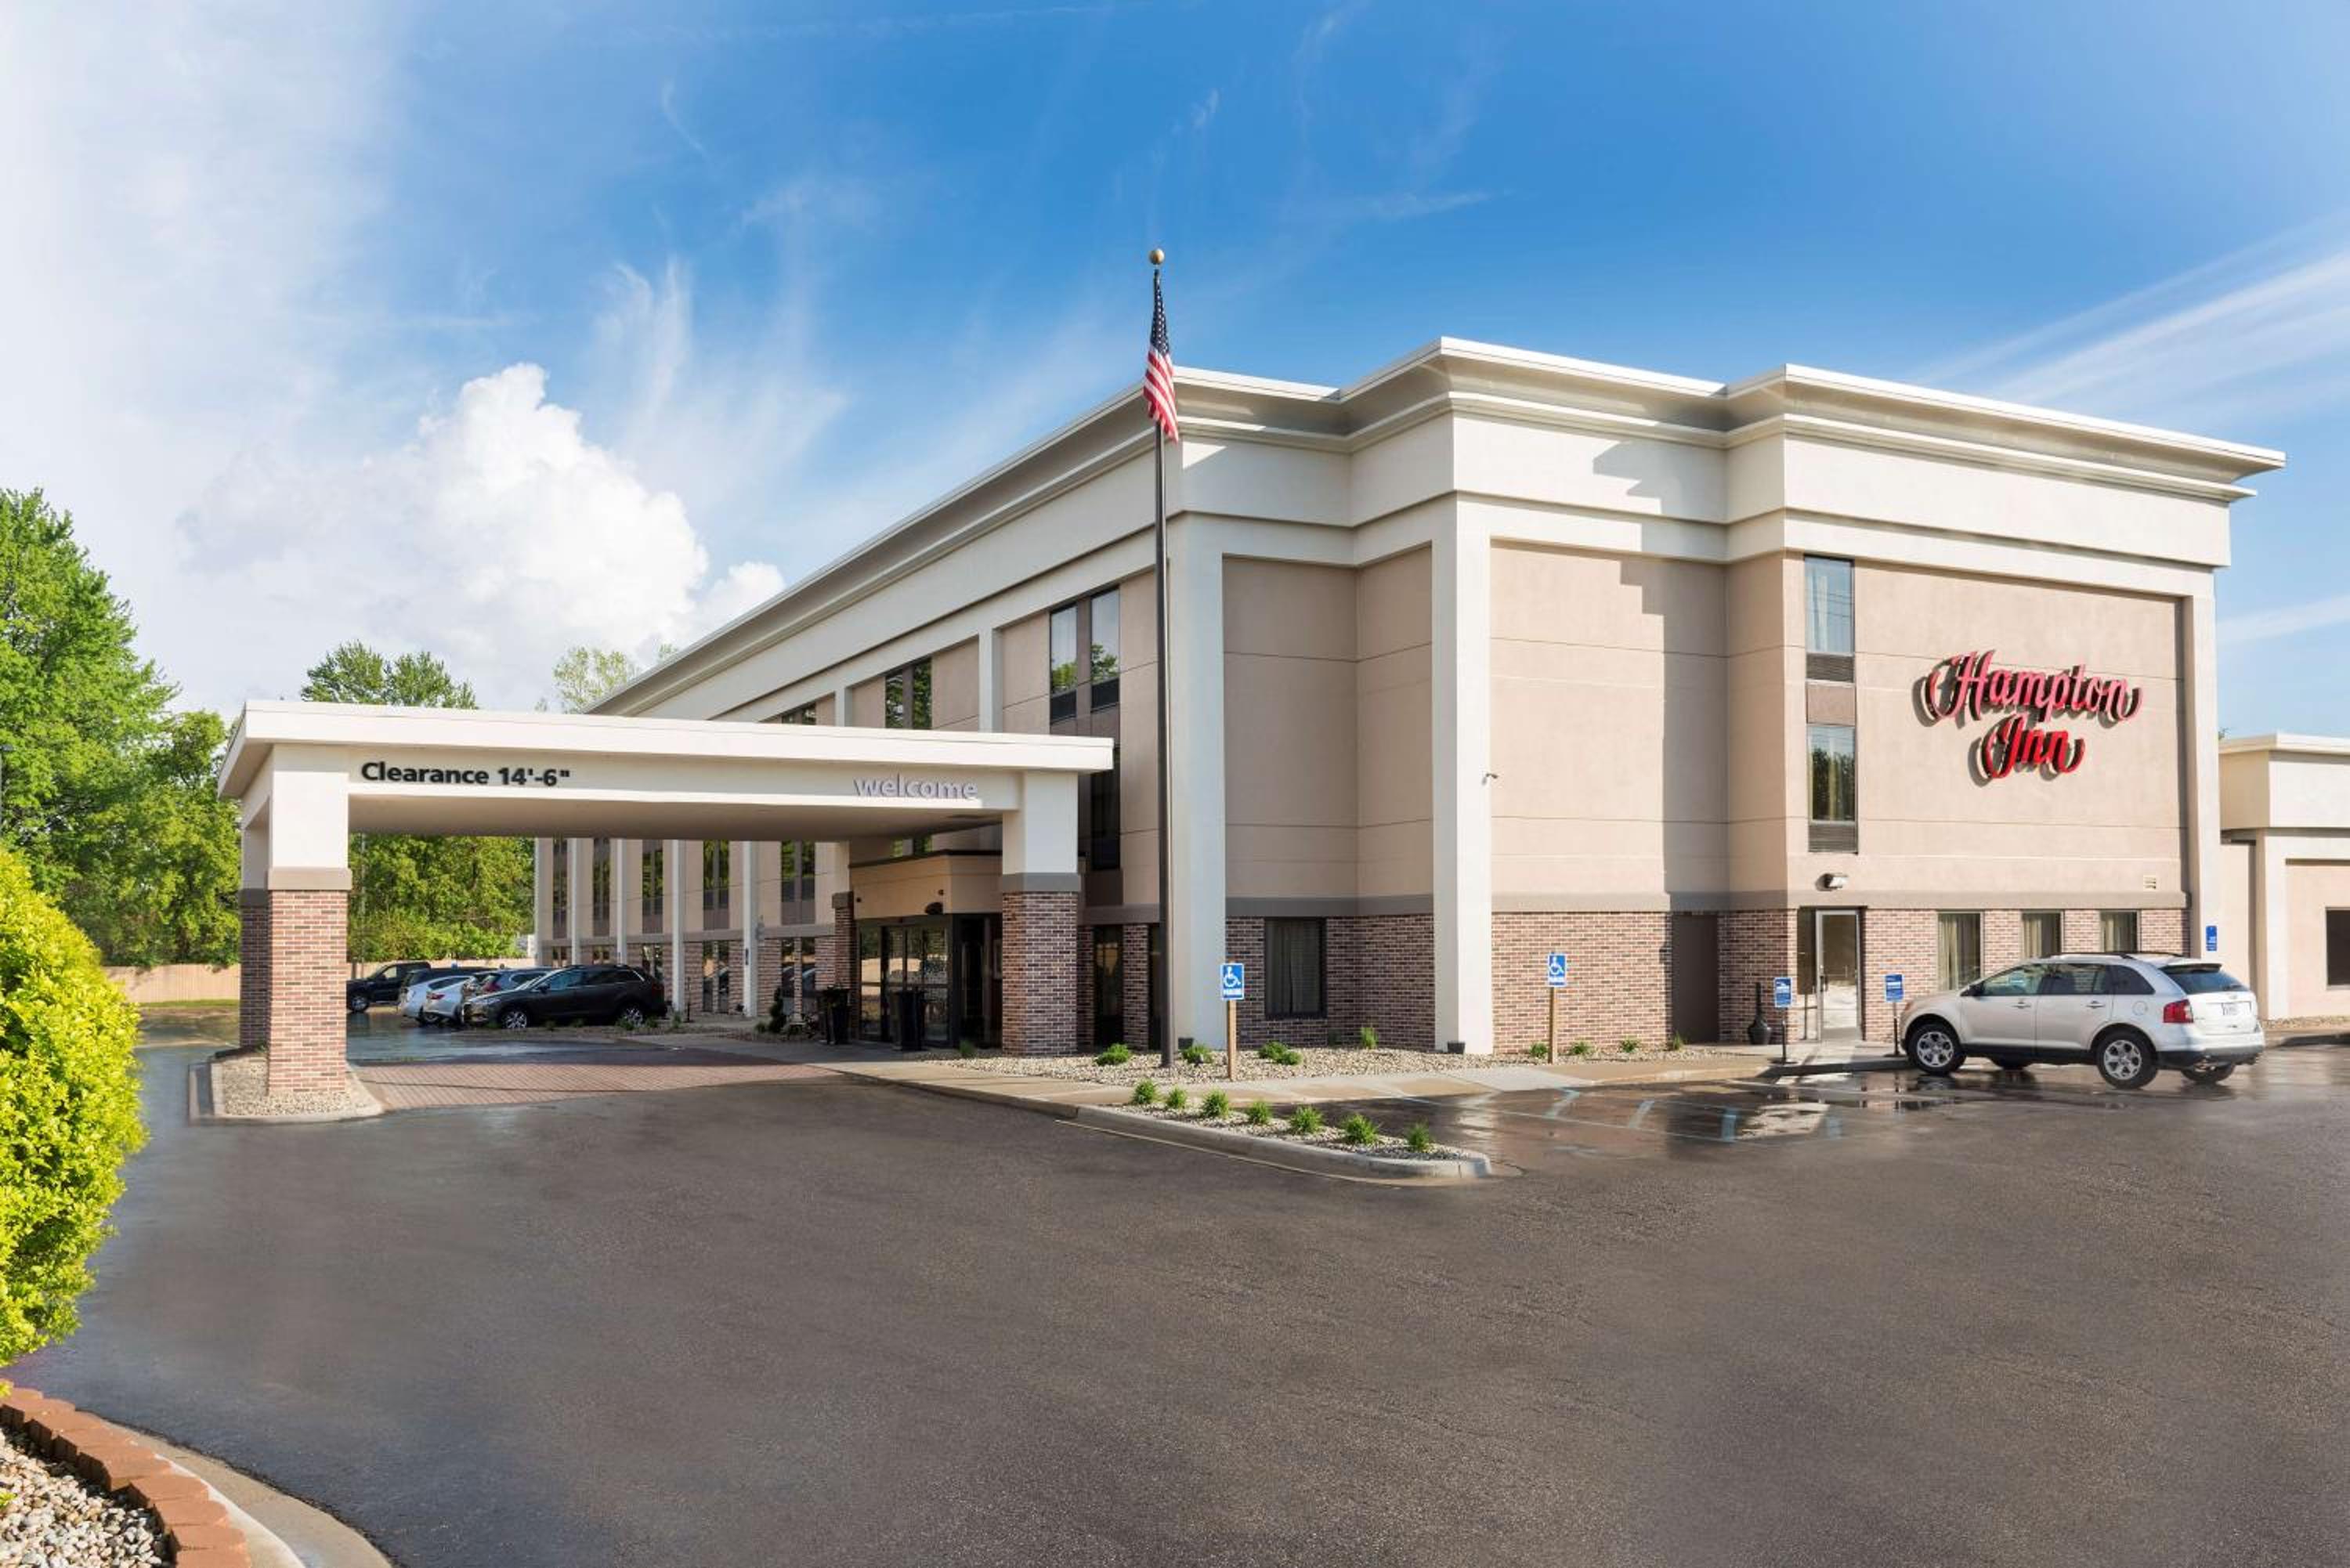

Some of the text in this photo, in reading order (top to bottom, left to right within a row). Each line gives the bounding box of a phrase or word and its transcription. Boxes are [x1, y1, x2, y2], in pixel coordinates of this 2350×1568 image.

[1925, 649, 2142, 722] Hampton
[1982, 714, 2085, 779] Inn
[361, 761, 570, 786] Clearance 14'-6"
[853, 773, 978, 799] welcome
